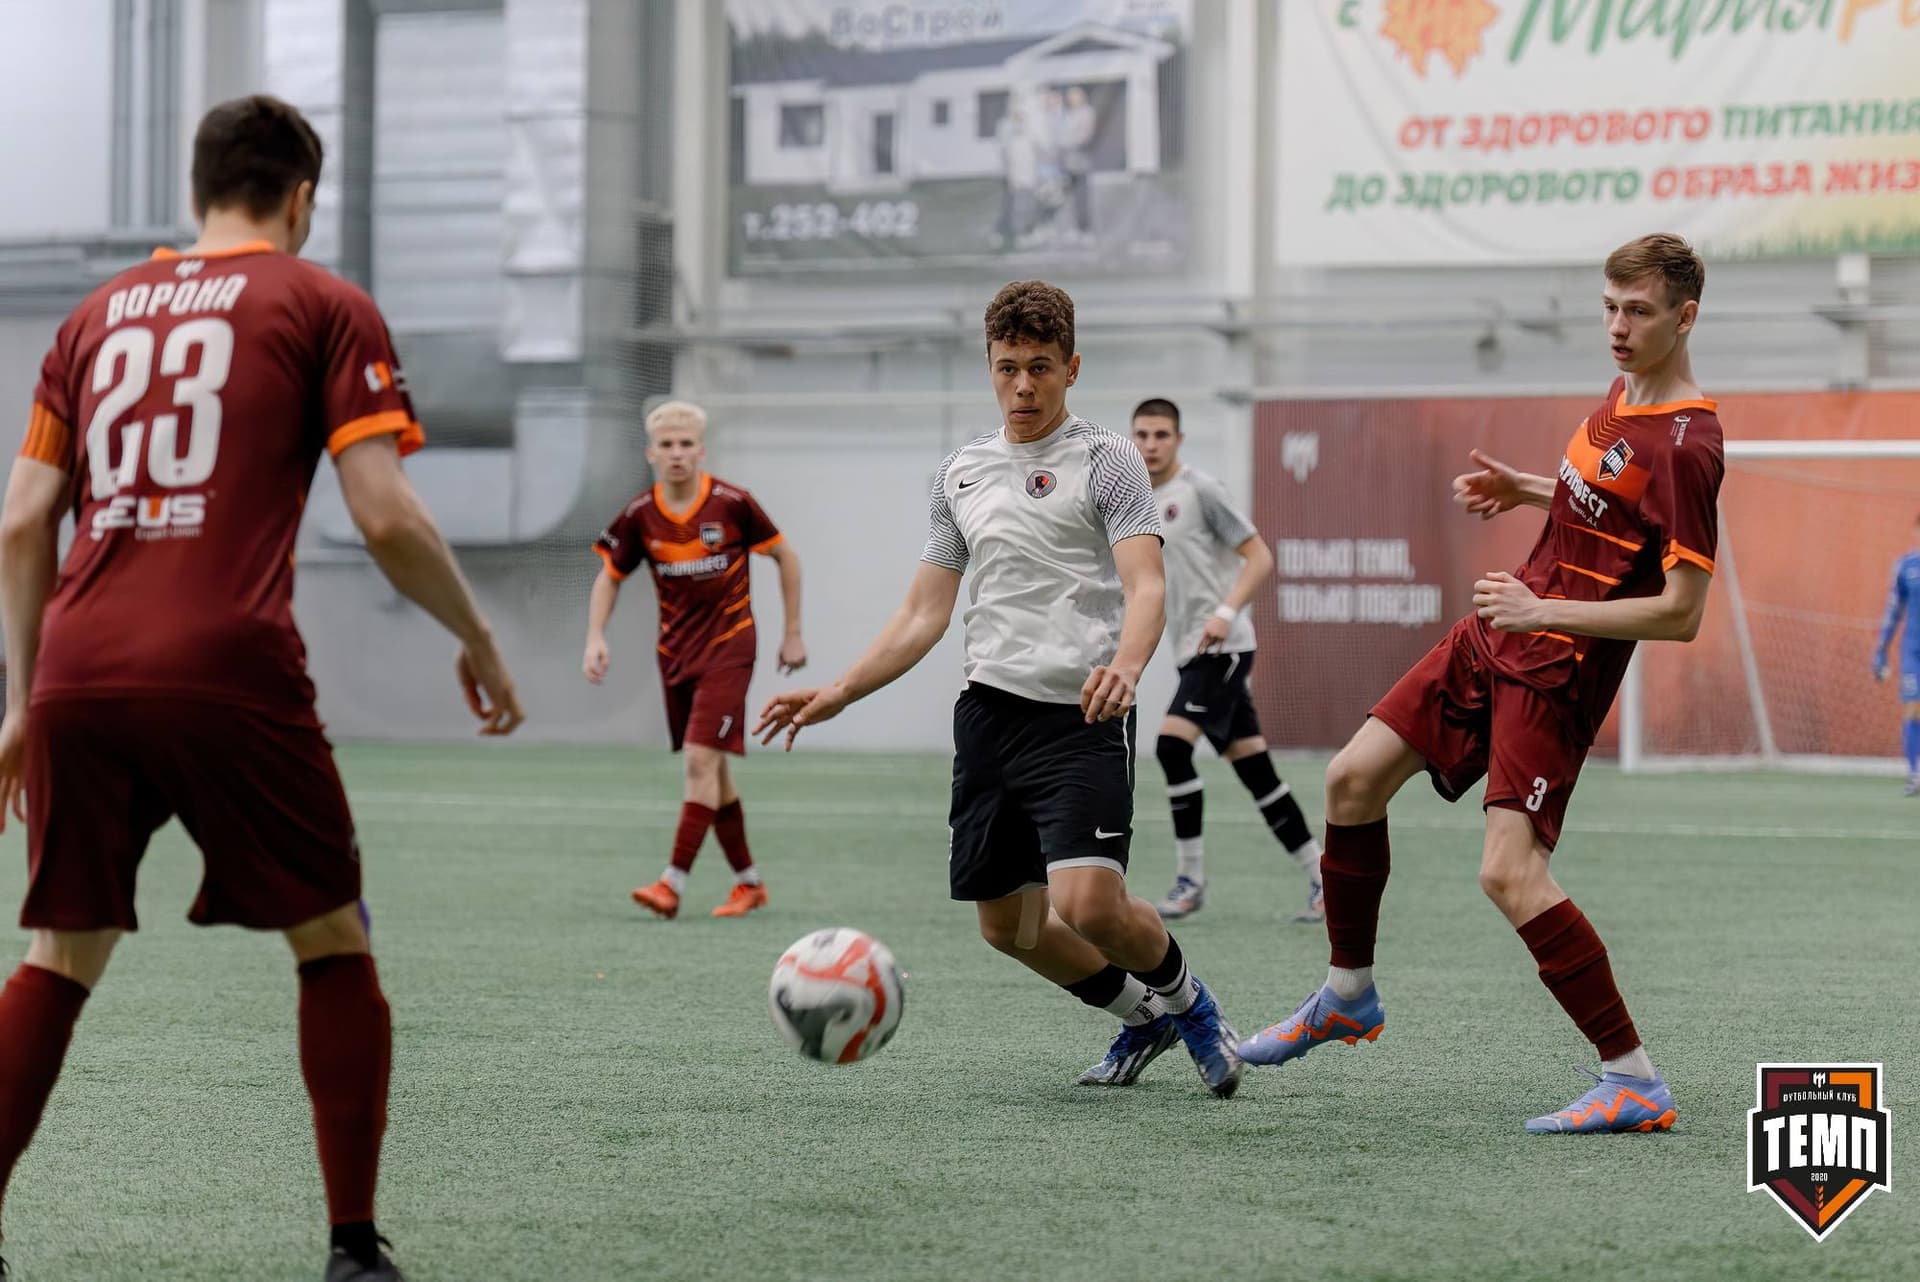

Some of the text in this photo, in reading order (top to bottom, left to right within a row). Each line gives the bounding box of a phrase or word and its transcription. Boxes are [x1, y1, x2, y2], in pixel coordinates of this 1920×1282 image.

[1398, 99, 1920, 155] ОТ ЗДОРОВОГО ПИТАНИЯ
[1324, 171, 1385, 212] ДО
[1393, 167, 1642, 210] ЗДОРОВОГО
[1651, 161, 1813, 200] ОБРАЗА
[106, 273, 248, 328] ВОРОНА
[86, 317, 235, 501] 23
[1526, 776, 1548, 812] 3
